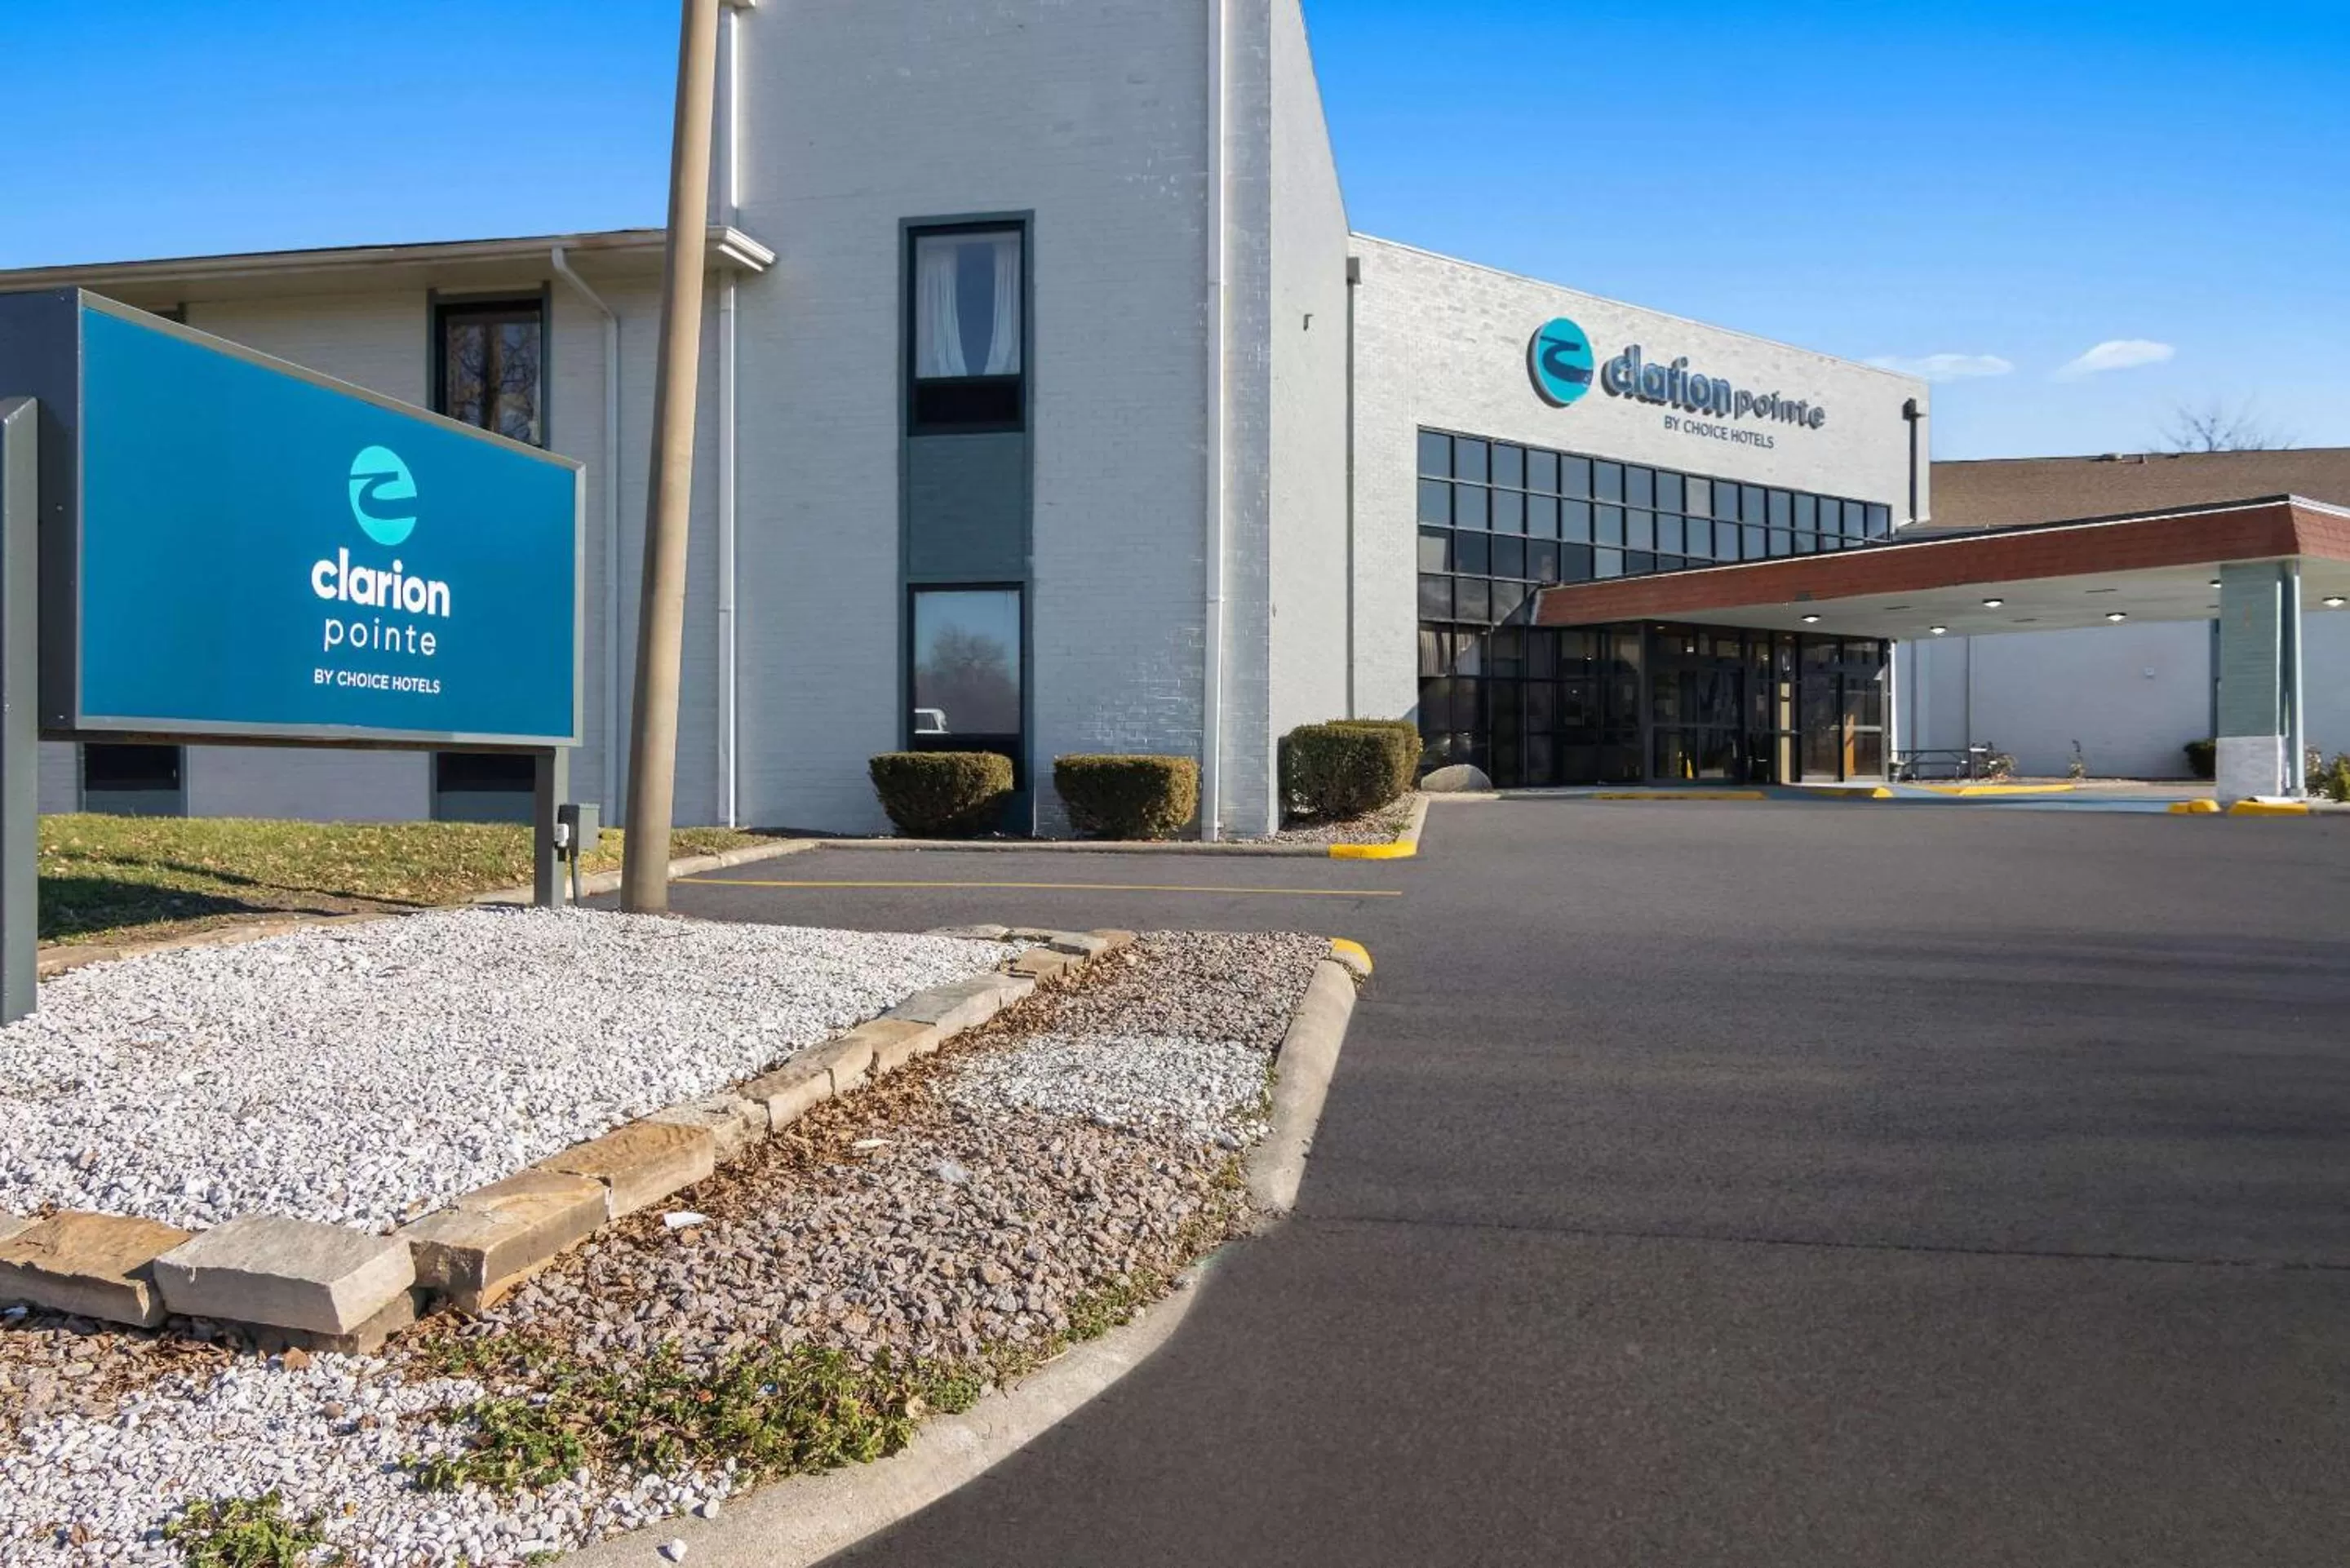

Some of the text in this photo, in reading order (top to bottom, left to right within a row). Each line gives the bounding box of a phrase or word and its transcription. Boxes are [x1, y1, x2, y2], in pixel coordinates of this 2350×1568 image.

[1602, 344, 1825, 429] clarion pointe
[1665, 415, 1774, 449] BY CHOICE HOTELS
[311, 547, 450, 617] clarion
[324, 618, 437, 655] pointe
[314, 669, 441, 693] BY CHOICE HOTELS
